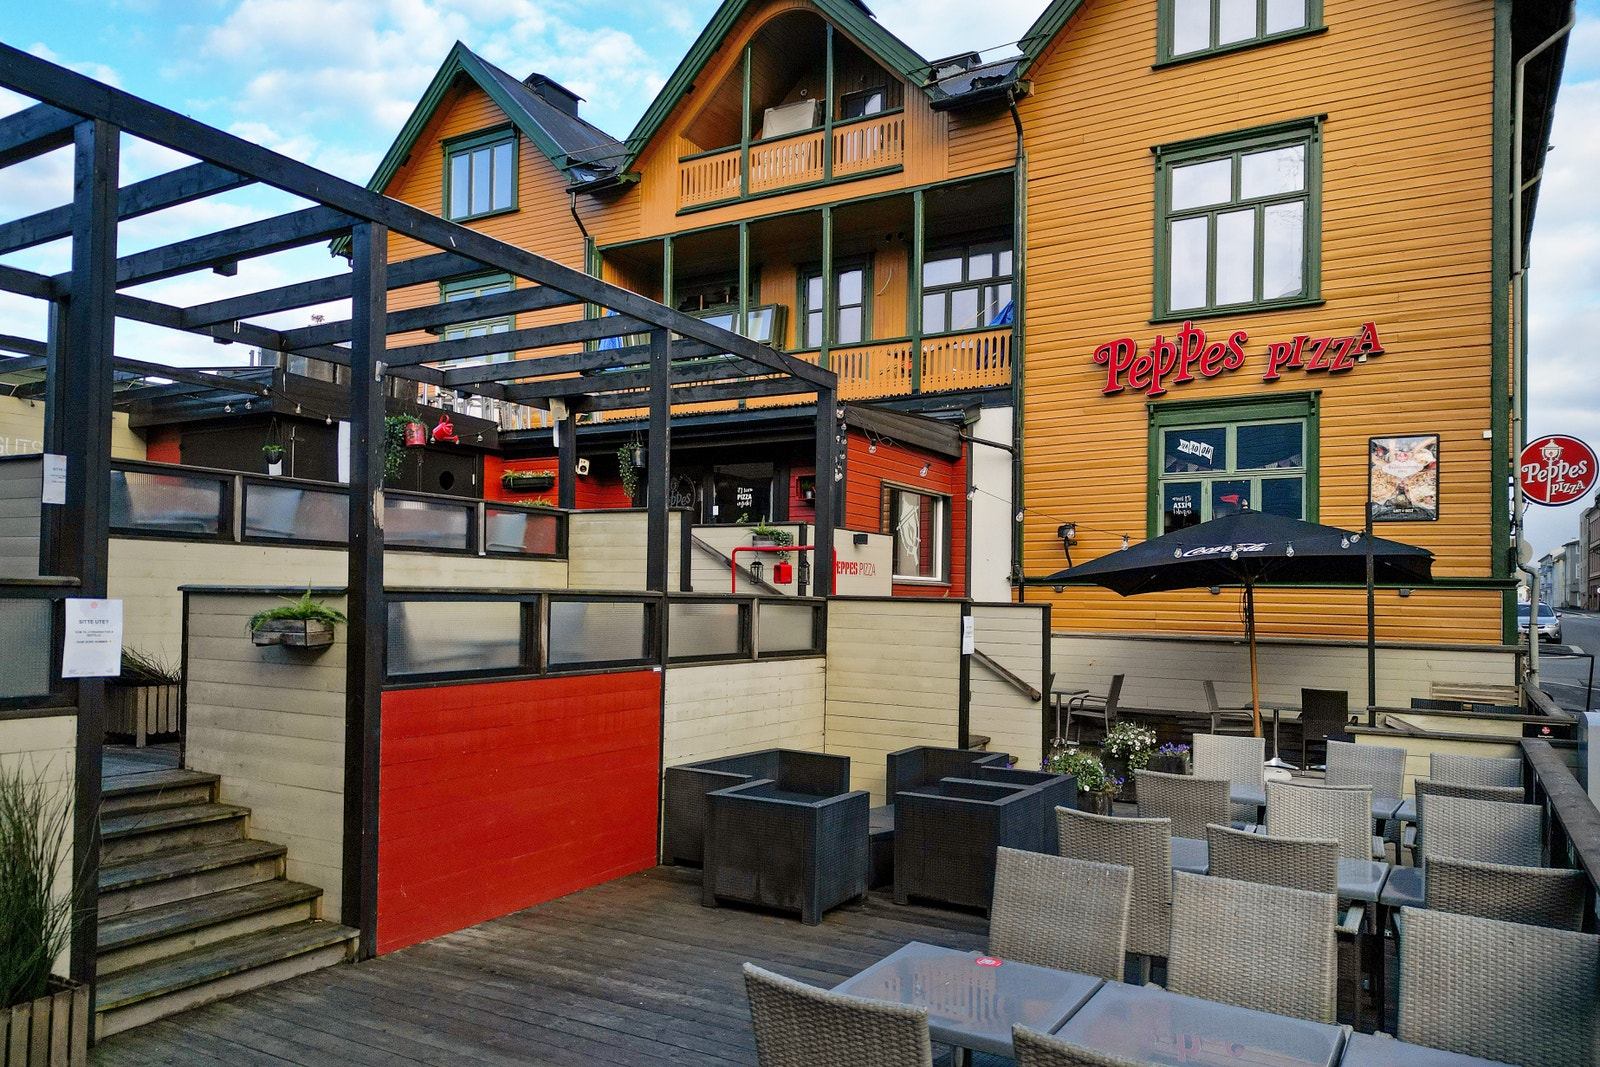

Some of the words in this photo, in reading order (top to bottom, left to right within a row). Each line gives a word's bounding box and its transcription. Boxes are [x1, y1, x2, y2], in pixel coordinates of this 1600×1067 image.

[1093, 320, 1248, 396] Peppes
[1521, 460, 1588, 484] Peppes
[836, 561, 858, 575] EPPES
